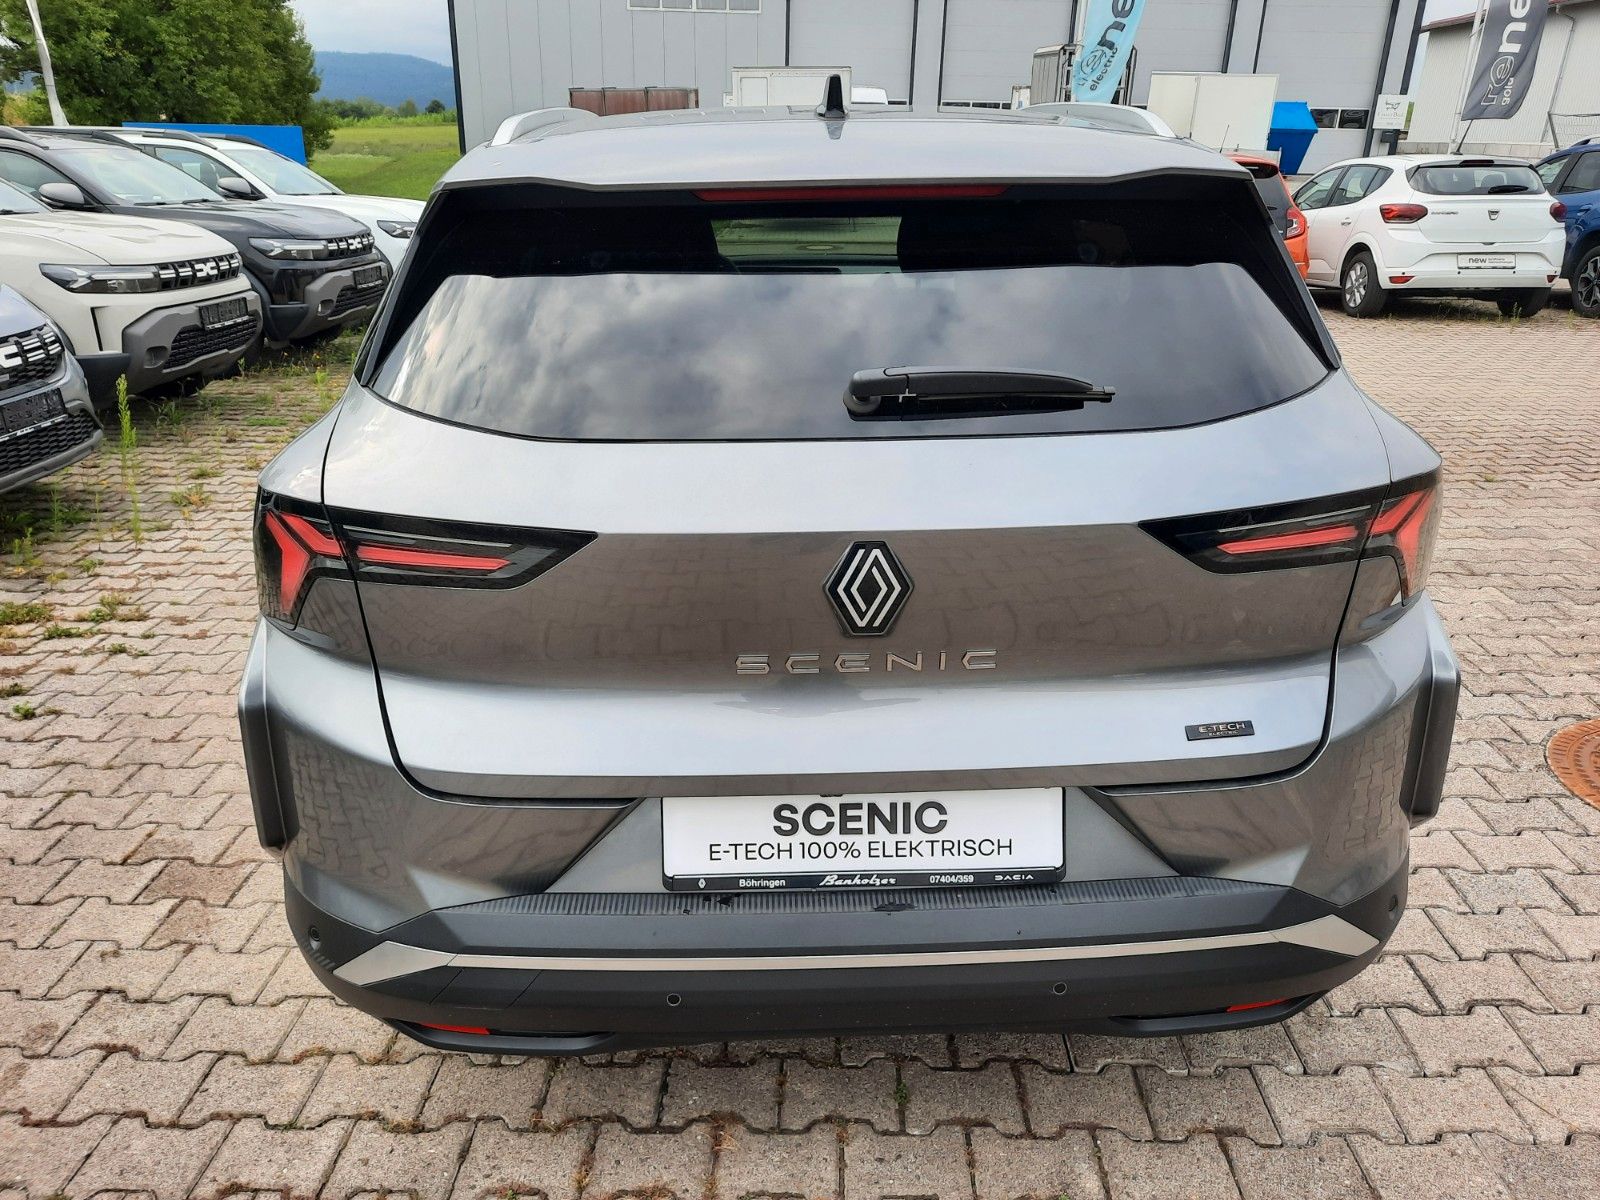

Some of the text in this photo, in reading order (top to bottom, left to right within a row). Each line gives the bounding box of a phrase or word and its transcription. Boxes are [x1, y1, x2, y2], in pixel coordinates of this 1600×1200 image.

[735, 650, 997, 675] SCENIC
[1198, 722, 1246, 733] E-TECH
[773, 800, 948, 837] SCENIC
[709, 838, 1012, 861] E-TECH 100% ELEKTRISCH
[739, 878, 786, 889] Böhringen
[929, 874, 974, 884] 07404/359
[994, 873, 1034, 881] DACIA
